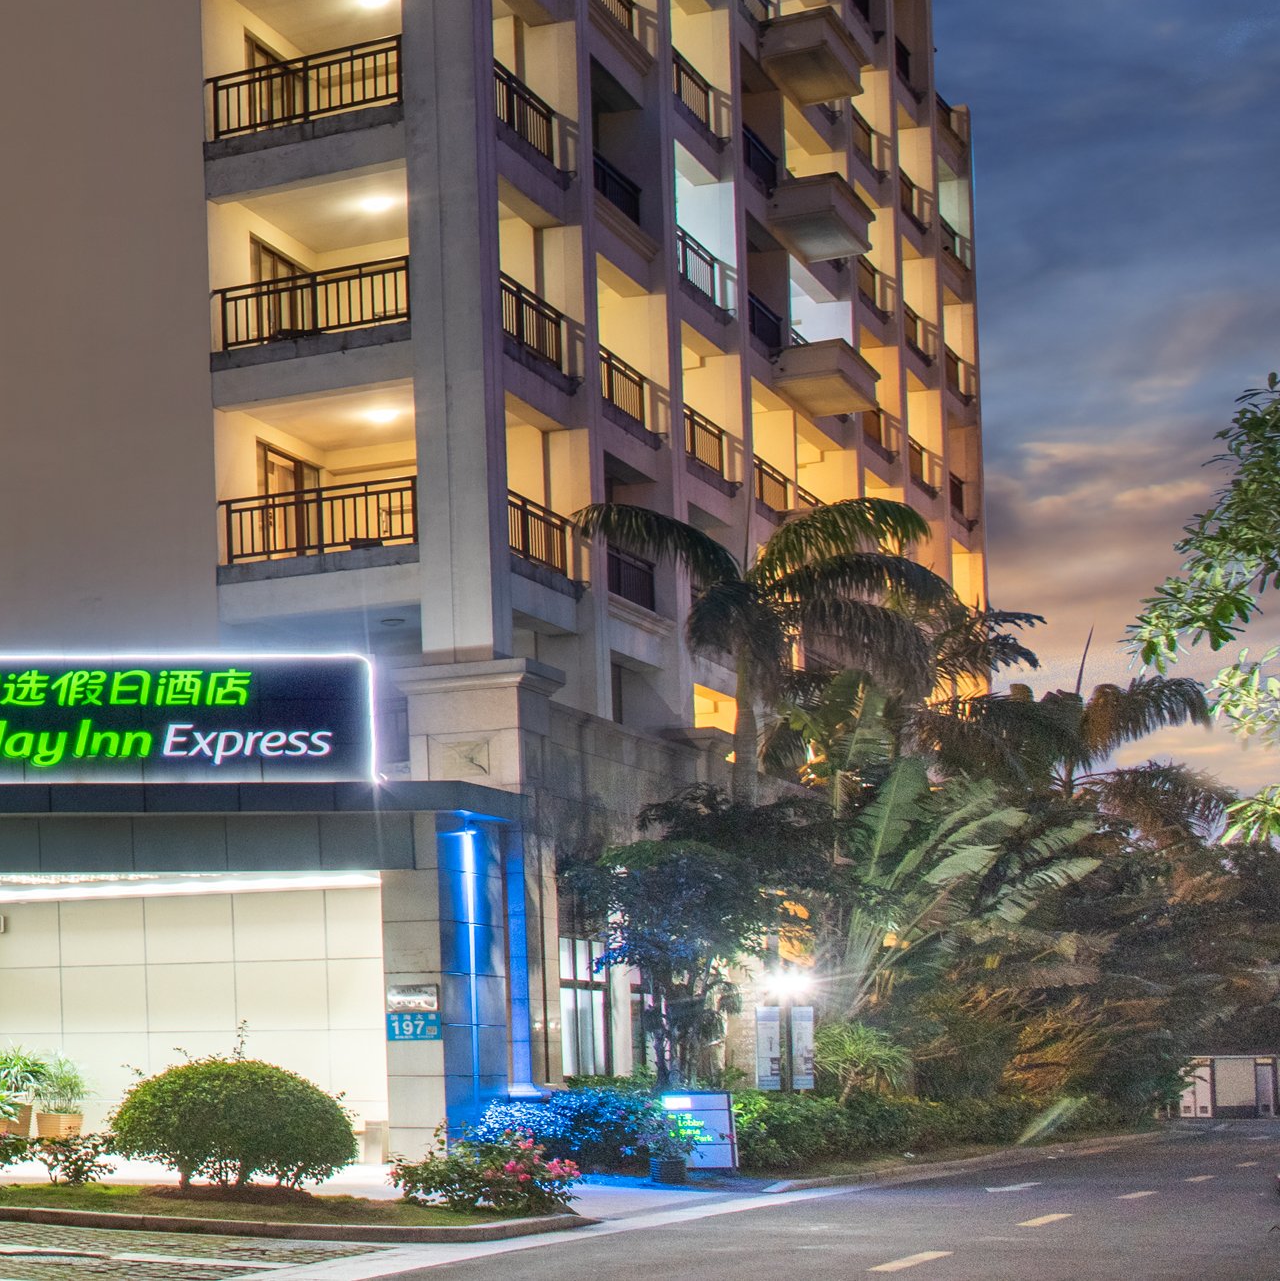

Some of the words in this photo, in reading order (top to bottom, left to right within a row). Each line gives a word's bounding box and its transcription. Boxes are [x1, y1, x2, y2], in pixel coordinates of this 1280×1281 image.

[72, 719, 153, 758] Inn
[162, 723, 333, 765] Express
[391, 1021, 425, 1035] 197
